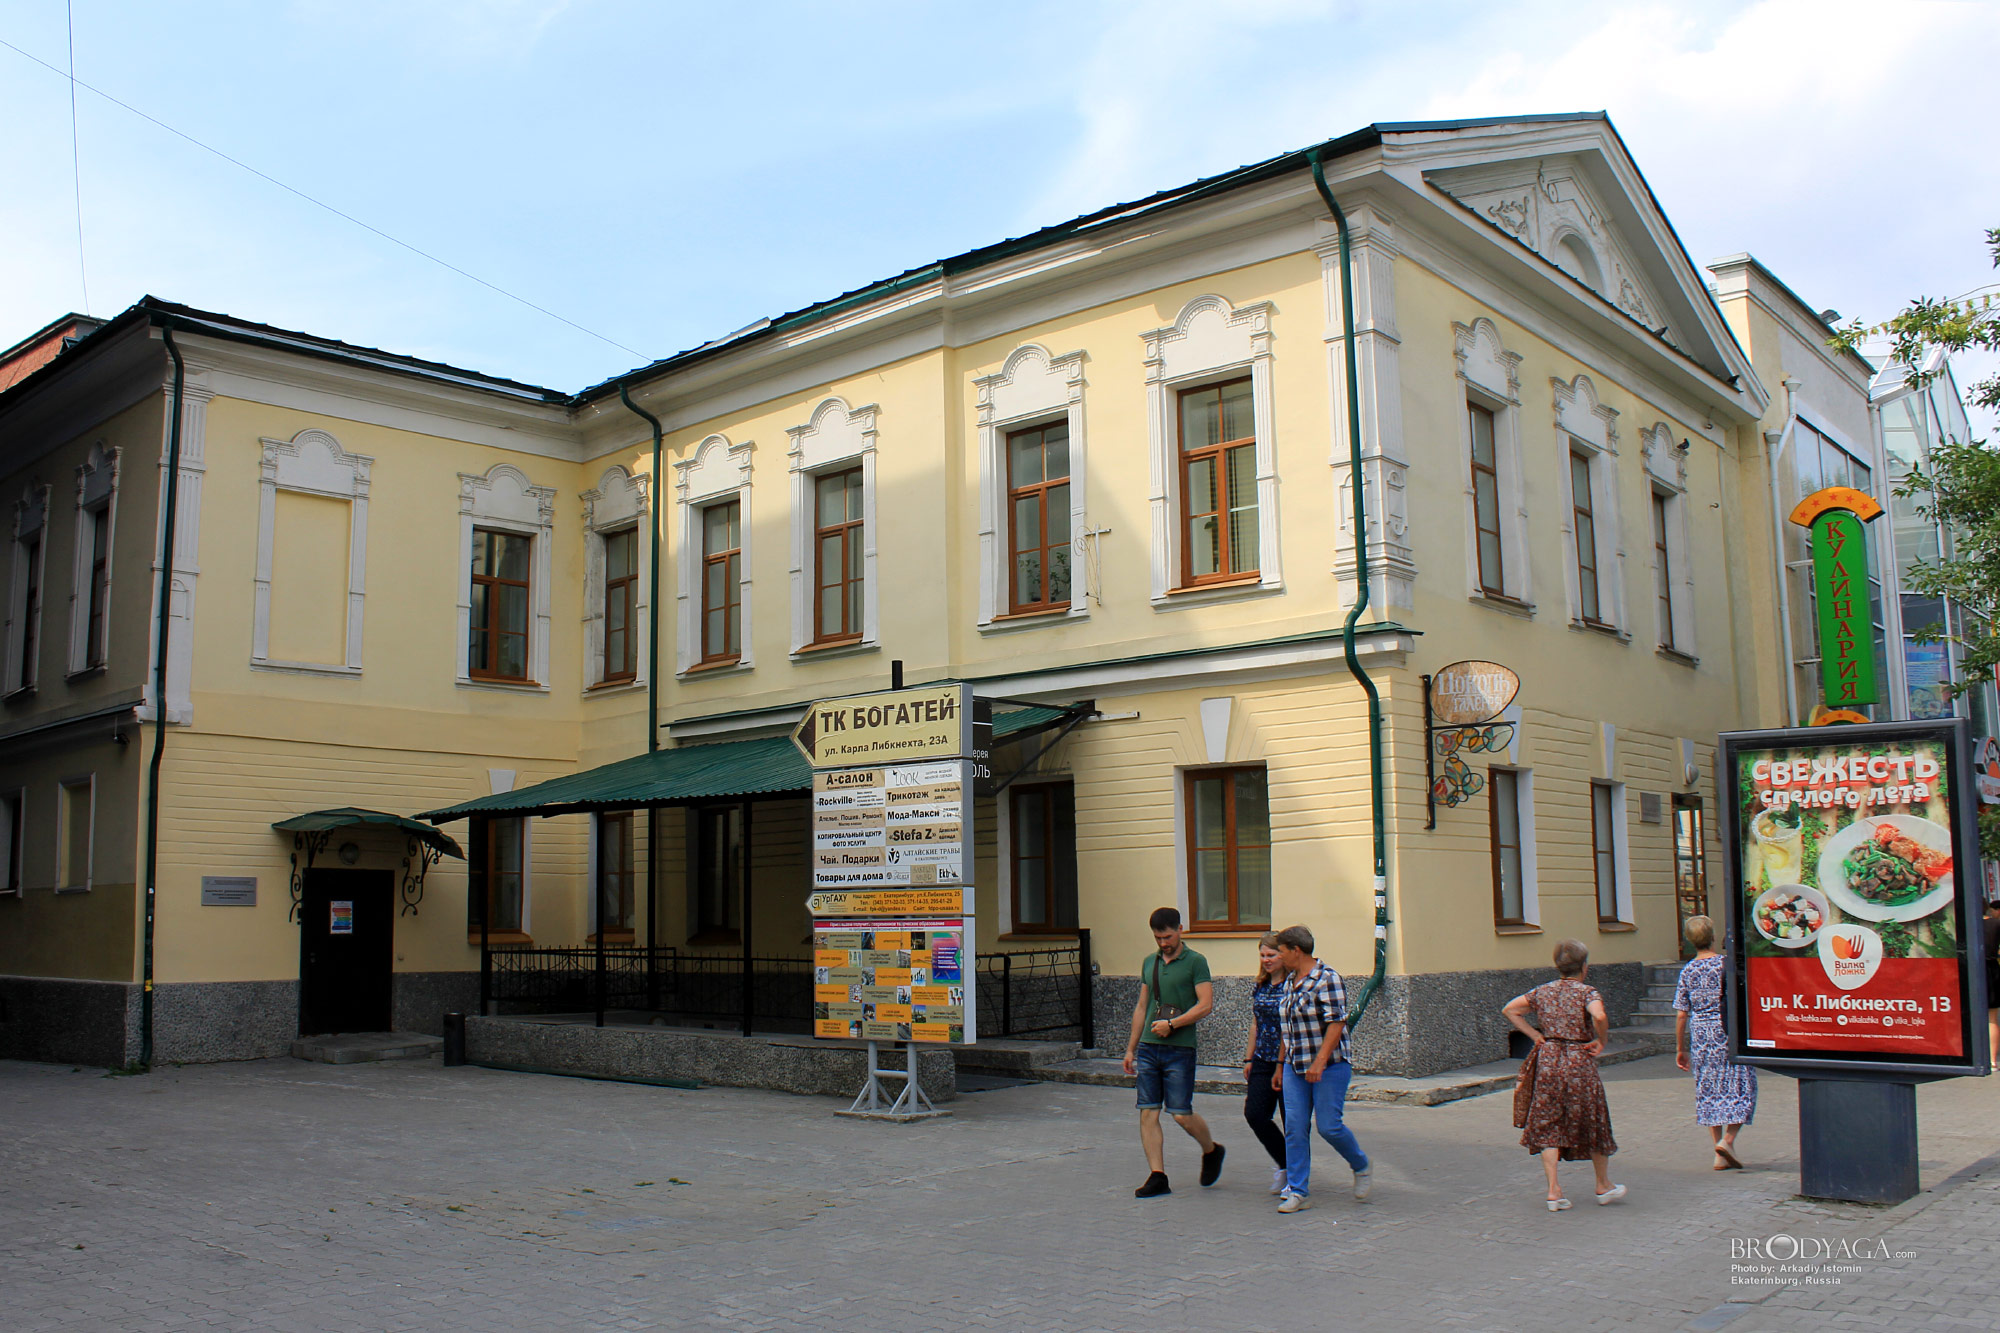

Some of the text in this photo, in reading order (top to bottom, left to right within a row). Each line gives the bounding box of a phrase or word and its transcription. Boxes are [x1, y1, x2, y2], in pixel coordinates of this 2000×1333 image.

[1823, 520, 1858, 700] КУЛИНАРИЯ
[821, 693, 955, 733] ТК БОГАТЕЙ
[825, 735, 948, 757] ул. Карла Либкнехта, 23А
[1752, 754, 1940, 788] СВЕЖЕСТЬ
[826, 772, 873, 785] А-салон
[887, 791, 929, 802] Трикотаж
[1867, 783, 1930, 805] лета
[817, 830, 864, 840] КОПИРОВАЛЬНЫЙ
[903, 847, 960, 856] АЛТАЙСКИЕ ТРАВЫ
[820, 854, 880, 865] Чай. Подарки
[816, 873, 846, 883] Товары
[847, 874, 861, 882] для
[862, 873, 884, 882] дома
[822, 893, 848, 904] УрГАХУ
[1760, 994, 1951, 1013] ул. К. Либкнехта, 13
